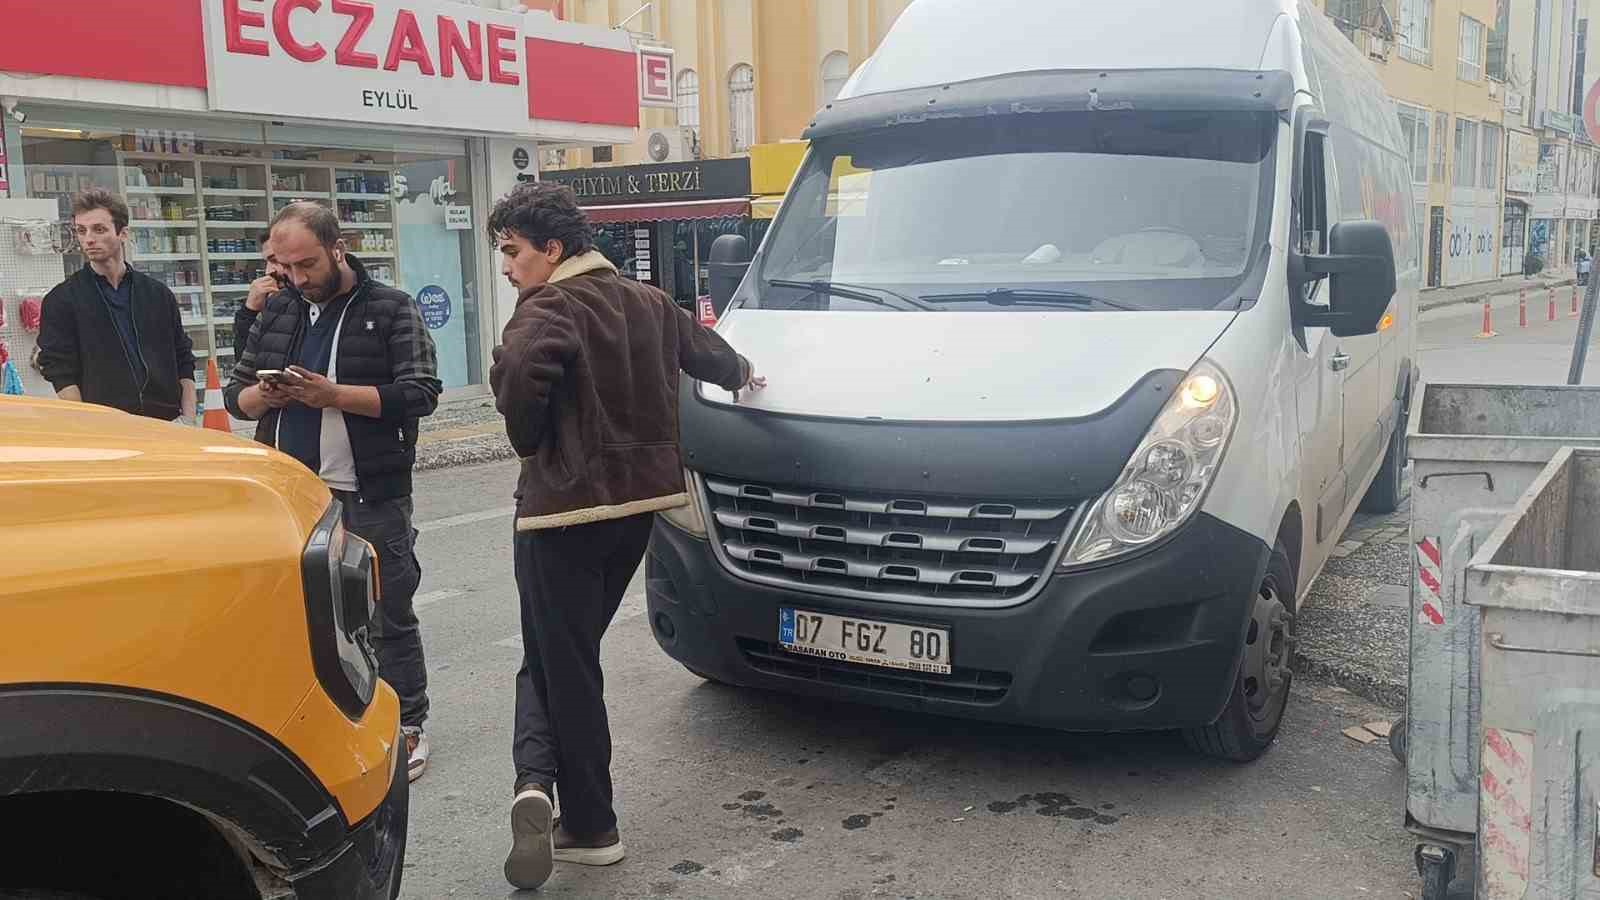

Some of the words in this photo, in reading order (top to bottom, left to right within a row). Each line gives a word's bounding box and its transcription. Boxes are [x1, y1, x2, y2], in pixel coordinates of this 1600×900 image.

[222, 0, 520, 86] ECZANE
[647, 59, 668, 96] E
[362, 89, 419, 110] EYLÜL
[627, 174, 641, 194] &
[645, 166, 703, 193] TERZİ
[783, 627, 793, 638] TR
[796, 614, 824, 644] 07
[841, 620, 887, 655] FGZ
[910, 629, 941, 661] 80
